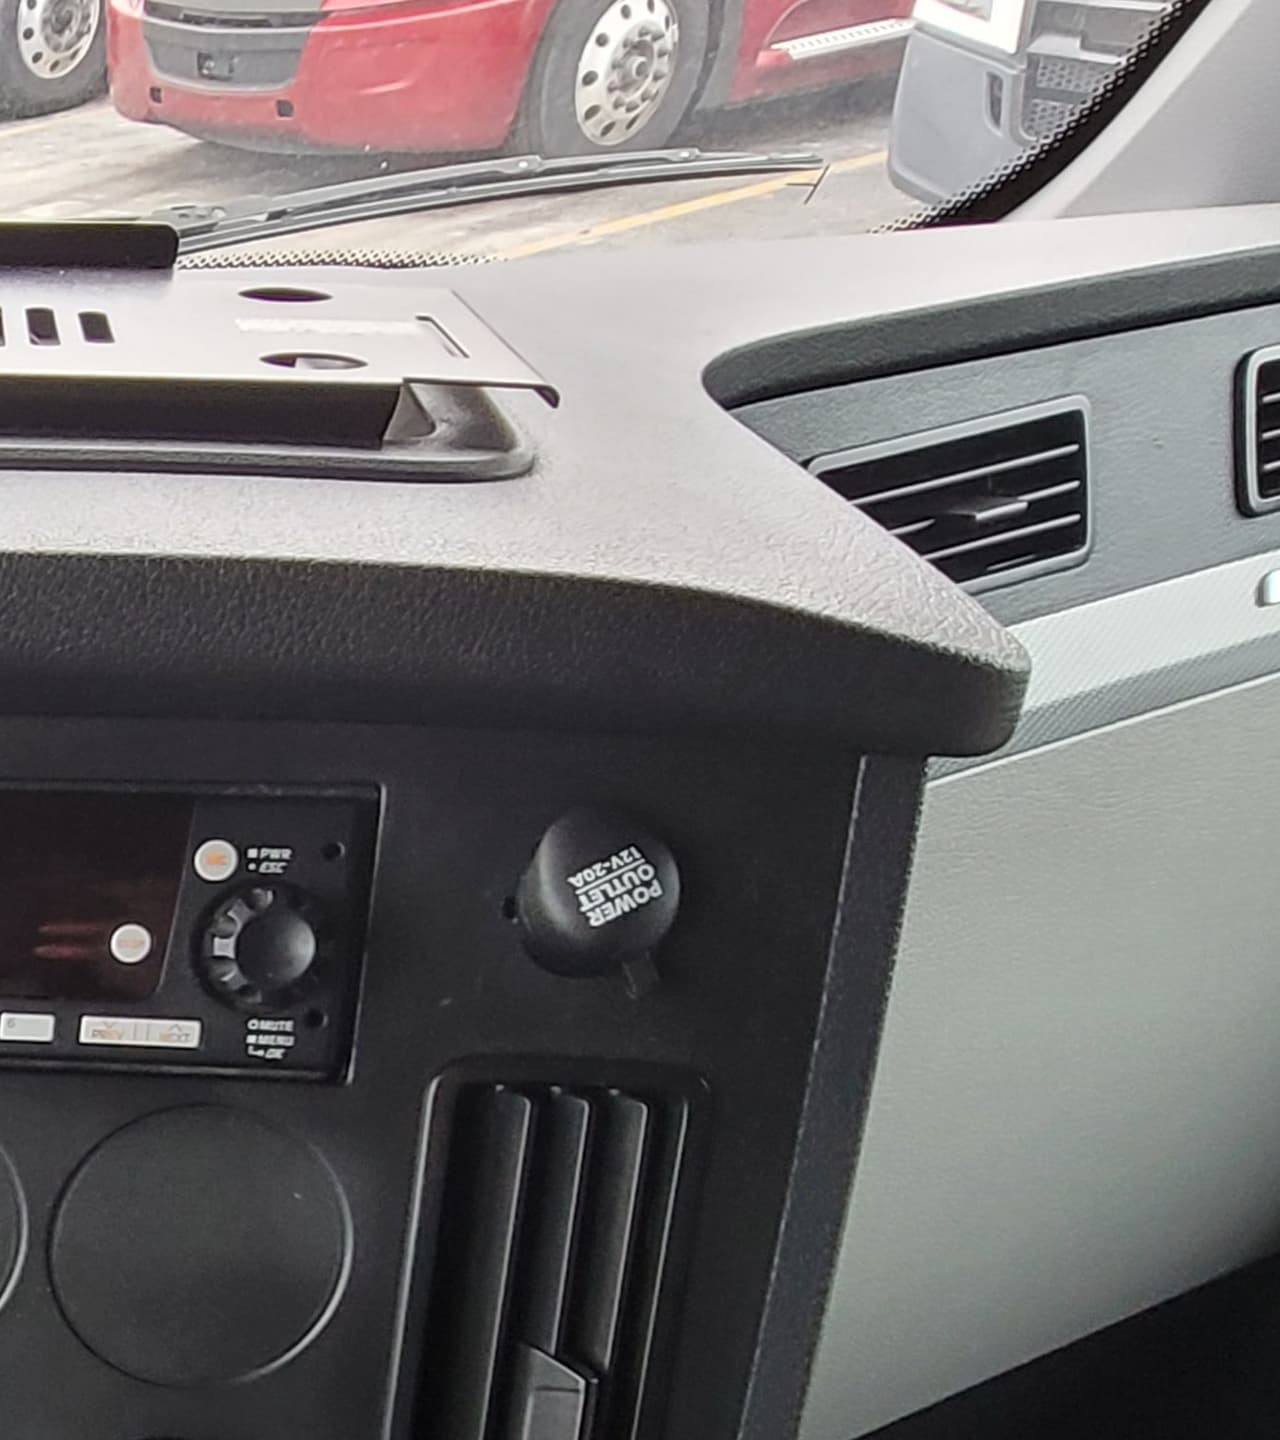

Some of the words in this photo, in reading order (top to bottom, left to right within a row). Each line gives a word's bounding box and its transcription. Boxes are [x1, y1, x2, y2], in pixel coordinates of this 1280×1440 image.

[566, 845, 643, 889] 12V-20A
[579, 863, 656, 913] OUTLET
[585, 878, 664, 928] POWER
